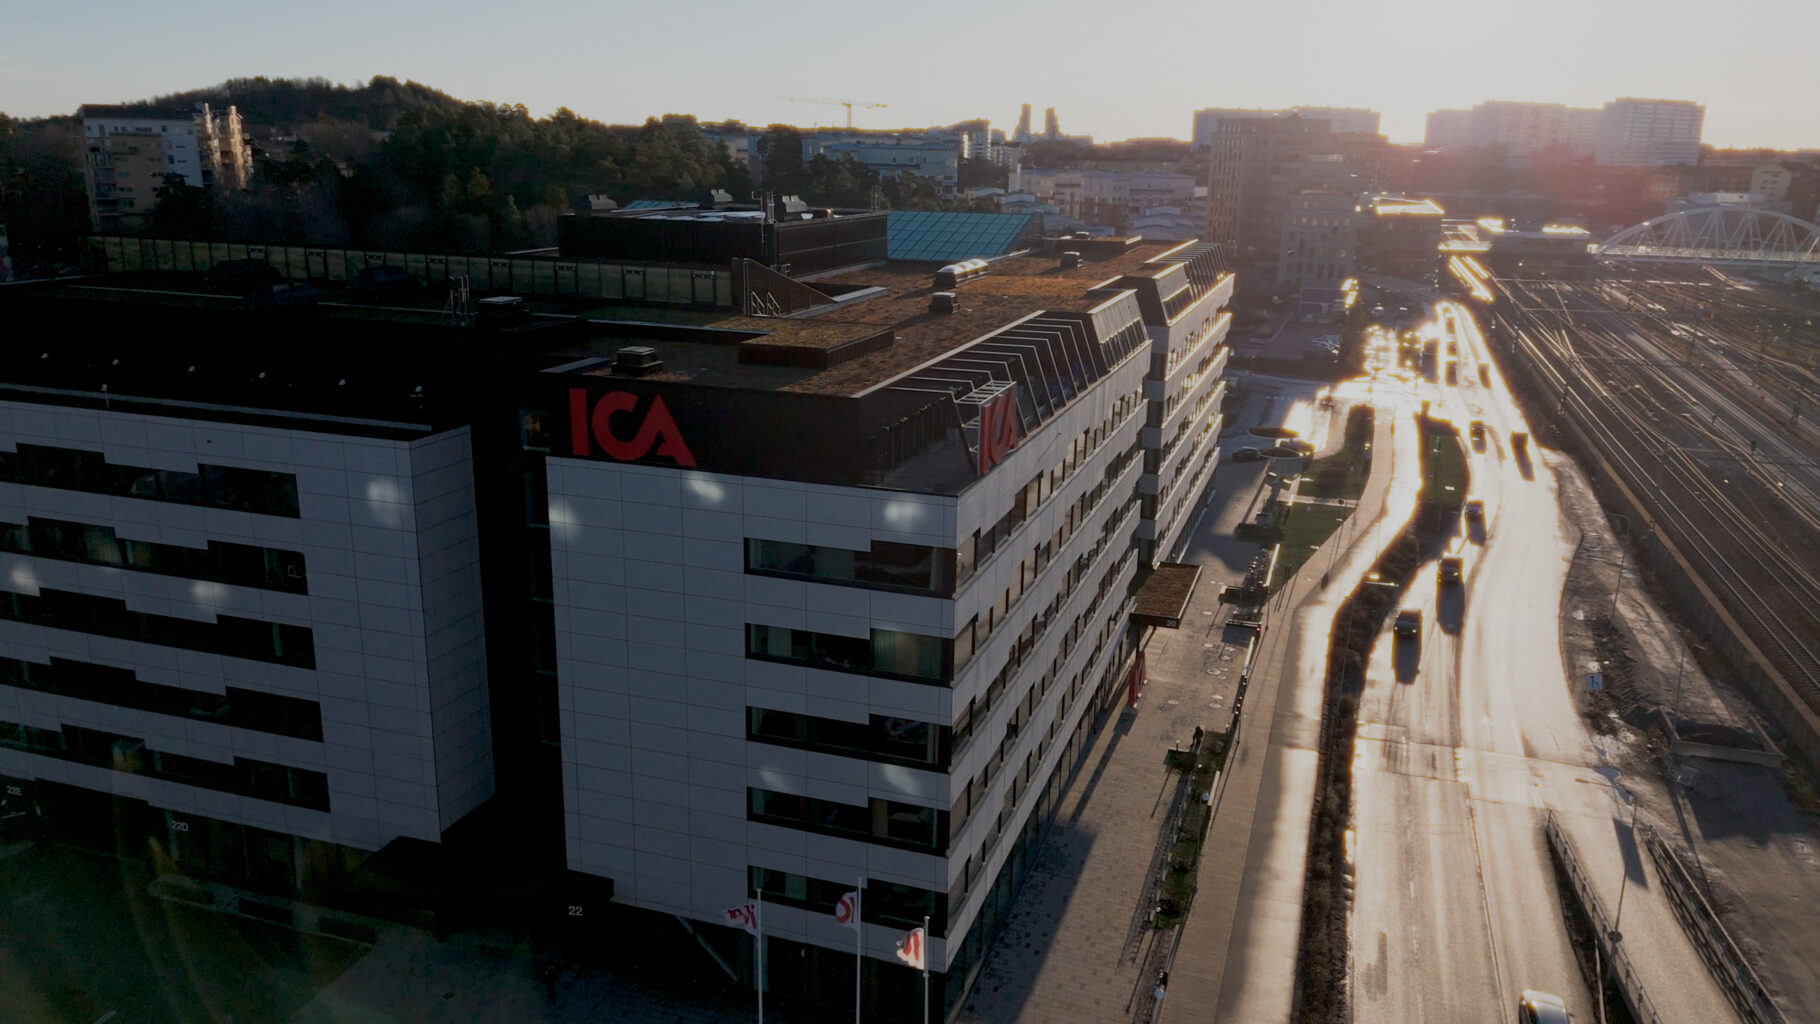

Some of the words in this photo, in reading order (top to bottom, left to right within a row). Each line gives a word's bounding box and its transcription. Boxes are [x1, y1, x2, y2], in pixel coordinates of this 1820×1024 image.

[568, 387, 697, 468] ICA
[980, 388, 1019, 475] ICA
[171, 820, 189, 832] 22D
[568, 905, 584, 917] 22
